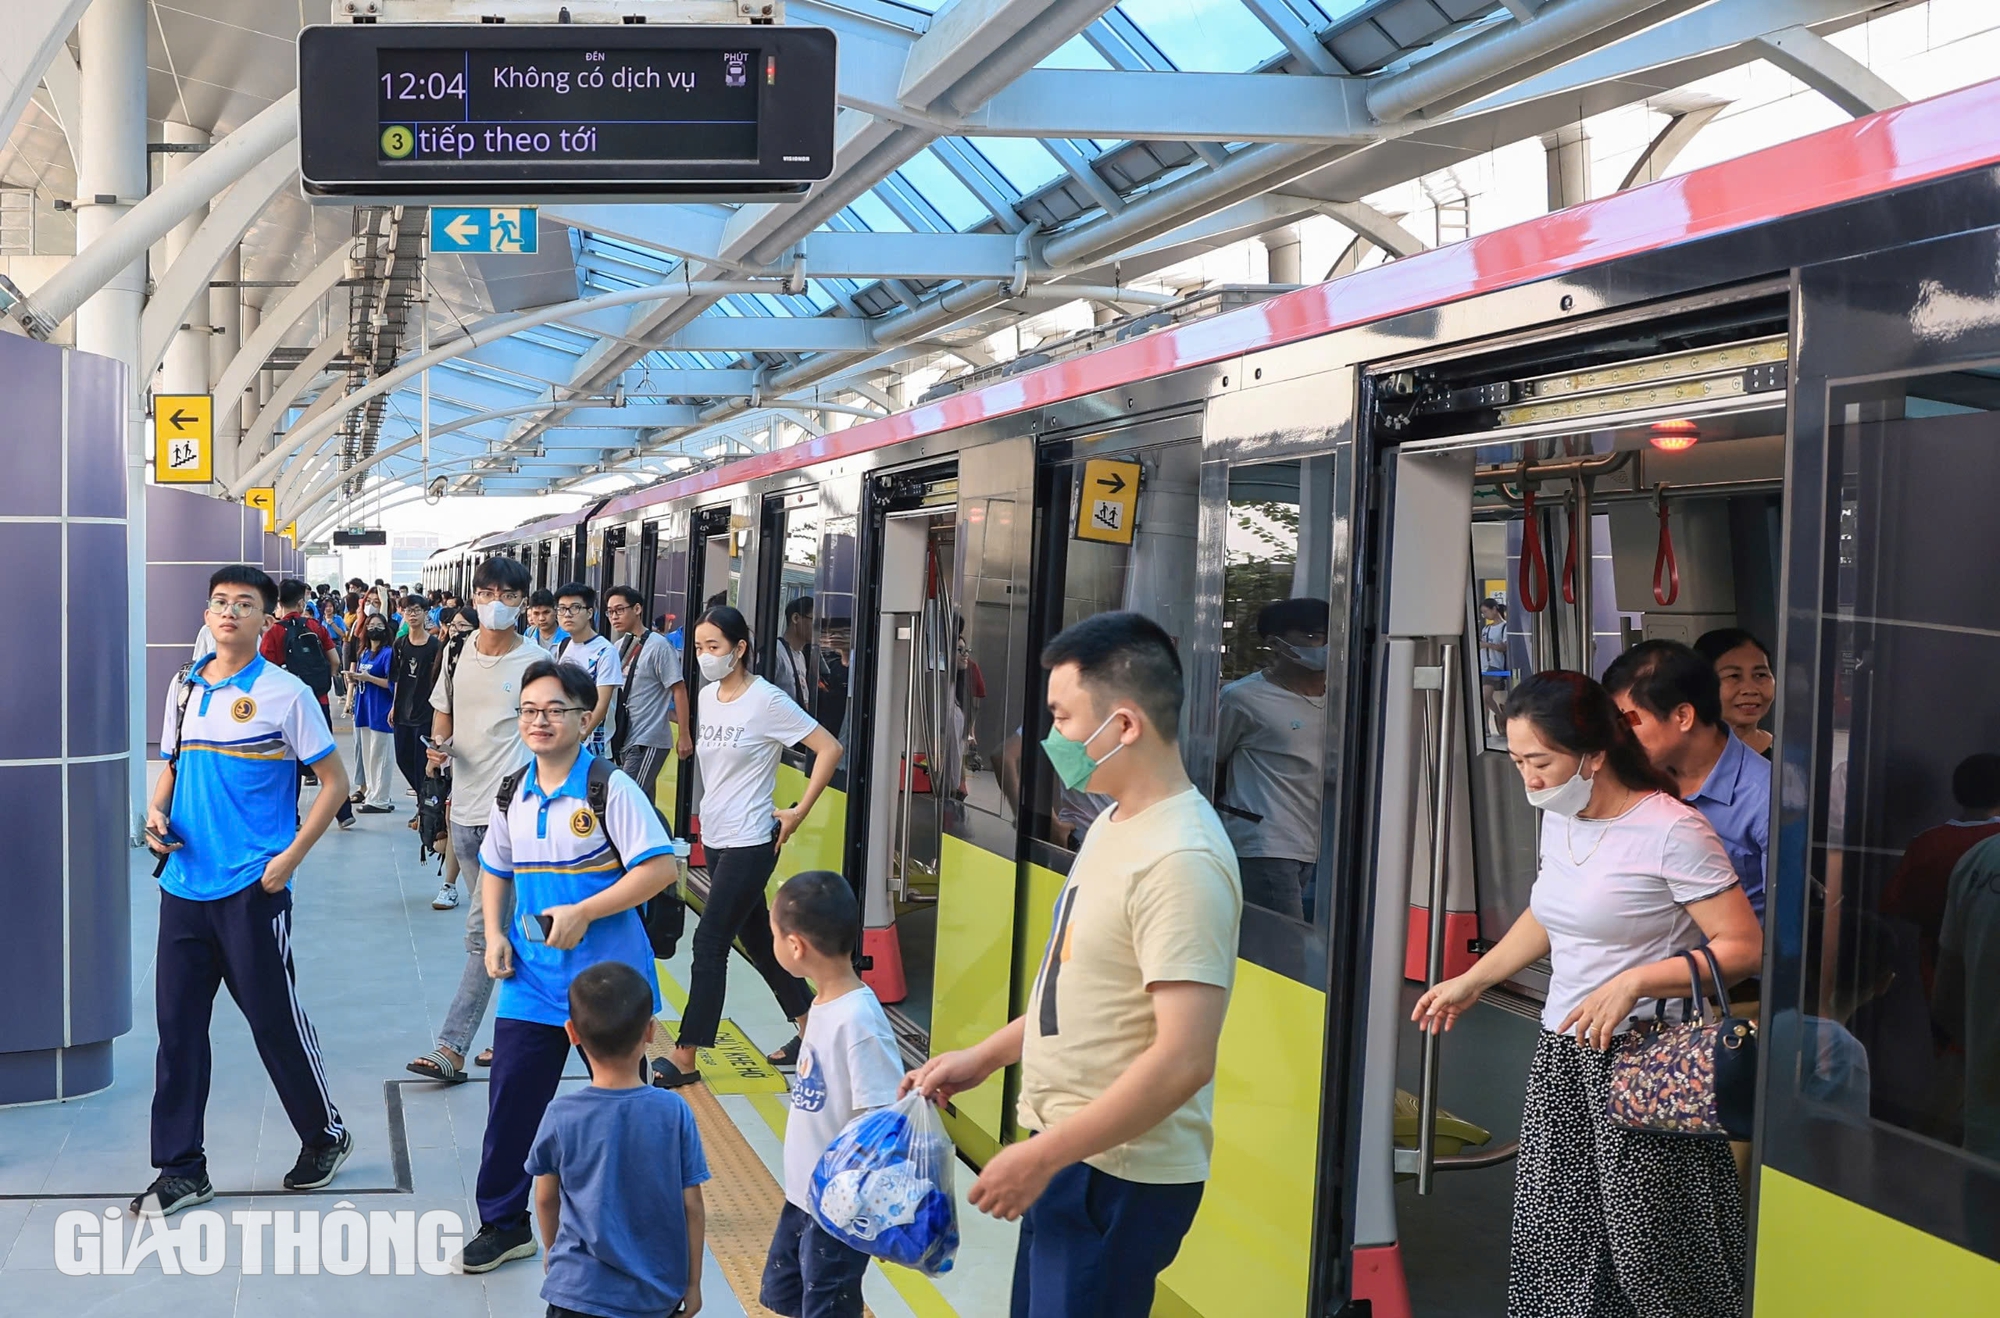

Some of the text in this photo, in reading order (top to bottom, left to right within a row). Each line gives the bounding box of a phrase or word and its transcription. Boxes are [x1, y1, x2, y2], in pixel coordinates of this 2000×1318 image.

[724, 51, 749, 62] PHÚT
[381, 72, 466, 100] 12:04
[494, 66, 696, 93] Không có dịch vụ
[391, 132, 404, 151] 3
[418, 124, 597, 159] tiếp theo tới
